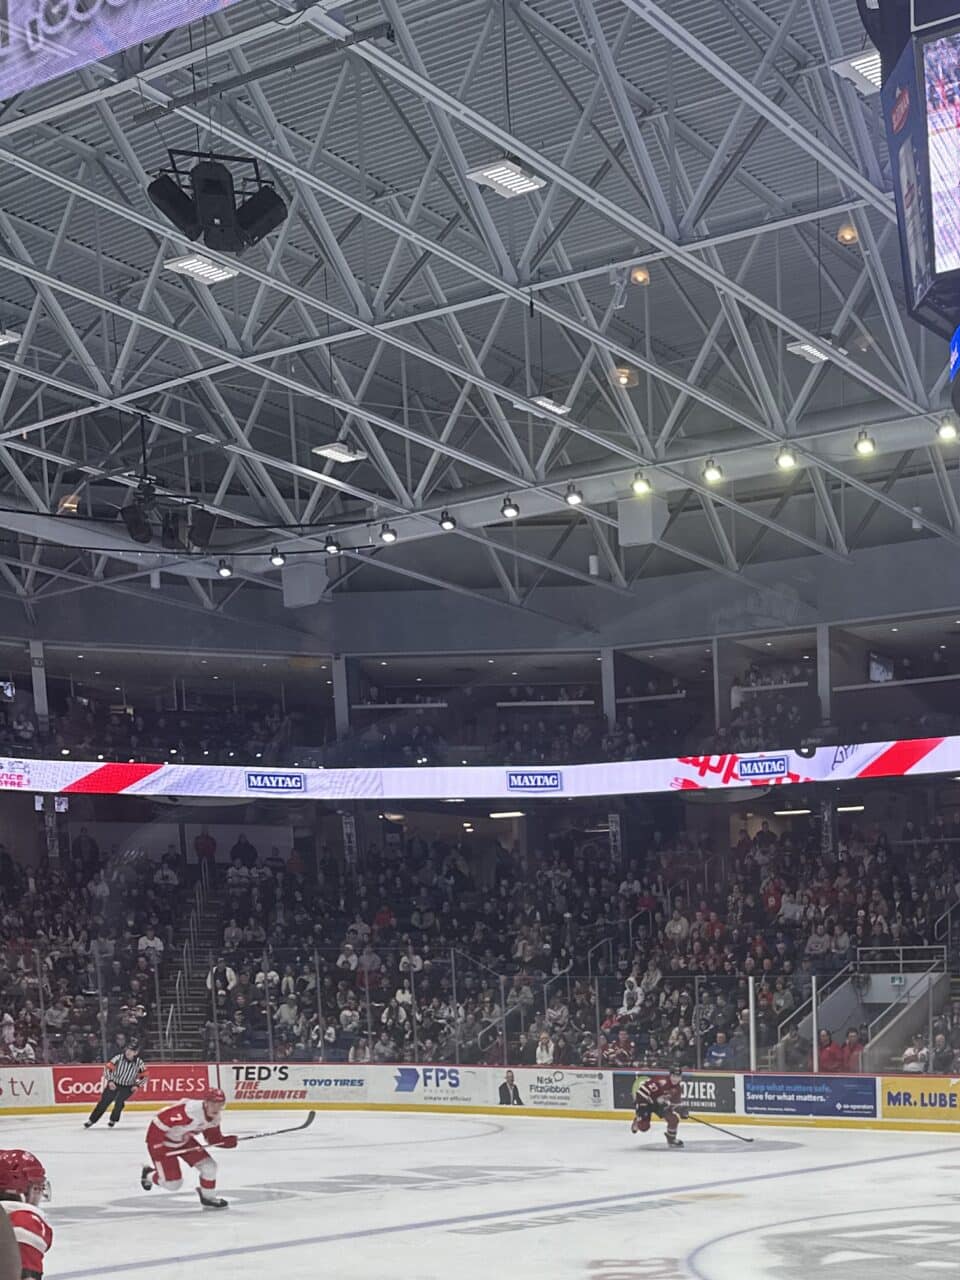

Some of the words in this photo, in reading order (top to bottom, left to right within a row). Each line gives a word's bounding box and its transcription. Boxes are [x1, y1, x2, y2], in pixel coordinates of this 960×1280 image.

[740, 760, 785, 776] MAYTAG
[249, 774, 302, 788] MAYTAG
[509, 774, 558, 788] MAYTAG
[232, 1066, 289, 1082] TED'S
[422, 1068, 460, 1088] FPS
[536, 1076, 553, 1085] Nick
[9, 1077, 34, 1096] tv
[142, 1078, 206, 1093] ITNESS
[234, 1081, 259, 1091] TIRE
[303, 1079, 333, 1088] TOYO
[333, 1079, 365, 1088] TIRES
[680, 1081, 716, 1100] OZIER
[235, 1089, 308, 1100] DISCOUNTER
[746, 1091, 764, 1101] Save
[765, 1092, 776, 1101] for
[776, 1093, 795, 1101] what
[887, 1091, 917, 1107] MR.
[920, 1092, 958, 1108] LUBE
